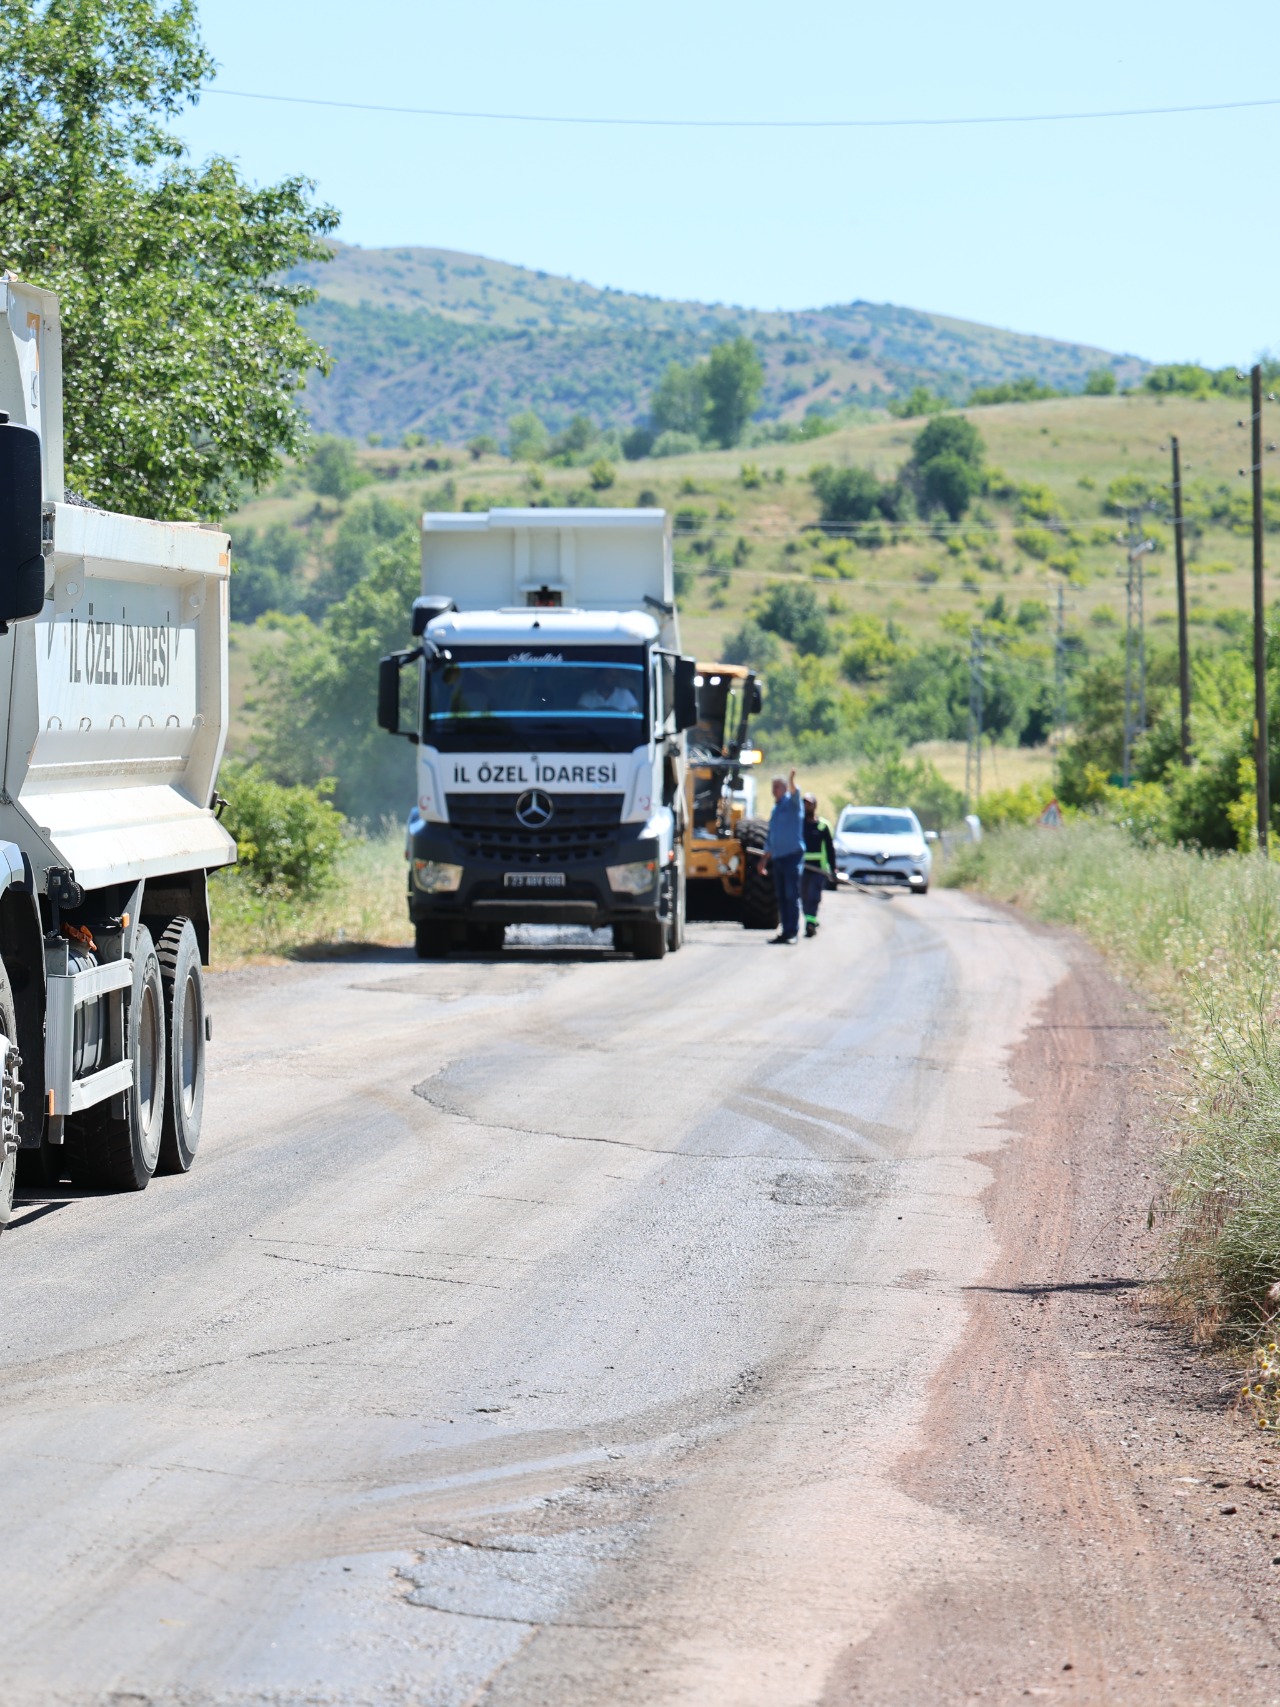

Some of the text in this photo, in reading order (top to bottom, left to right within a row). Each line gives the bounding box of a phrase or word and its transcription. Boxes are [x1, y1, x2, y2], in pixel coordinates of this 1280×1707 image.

[69, 602, 170, 687] İL ÖZEL İDARESİ
[454, 761, 617, 784] İL ÖZEL İDARESİ
